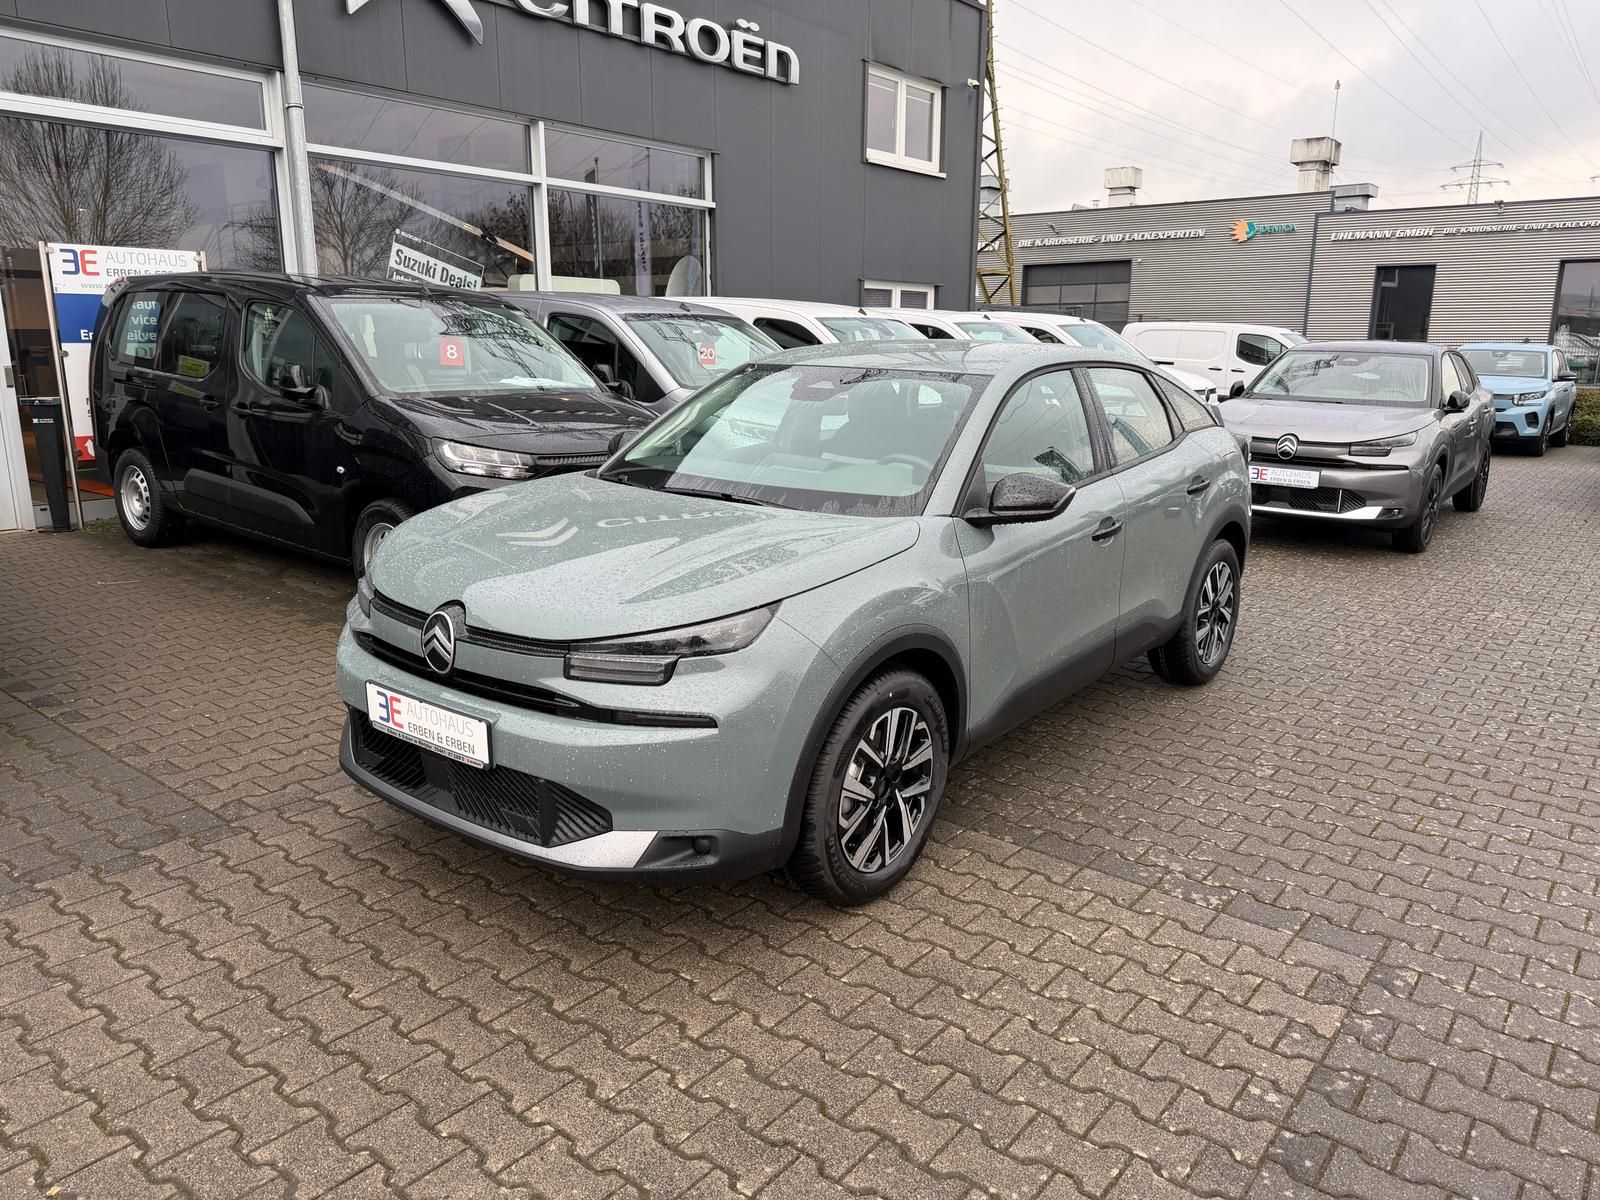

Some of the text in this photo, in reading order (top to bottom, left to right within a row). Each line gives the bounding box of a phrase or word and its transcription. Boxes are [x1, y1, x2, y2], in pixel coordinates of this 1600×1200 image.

[1018, 228, 1206, 248] DIE KAROSSERIE- UND LACKEXPERTEN
[1330, 230, 1393, 241] UHLMANN
[1443, 226, 1458, 235] DIE
[1524, 222, 1544, 231] UND
[105, 250, 188, 267] AUTOHAUS
[394, 248, 477, 289] Suzuki Deals!
[447, 344, 457, 359] 8
[700, 347, 715, 360] 20
[406, 702, 474, 737] AUTOHAUS
[407, 722, 435, 740] ERBEN
[437, 732, 444, 743] &
[445, 736, 475, 755] ERBEN
